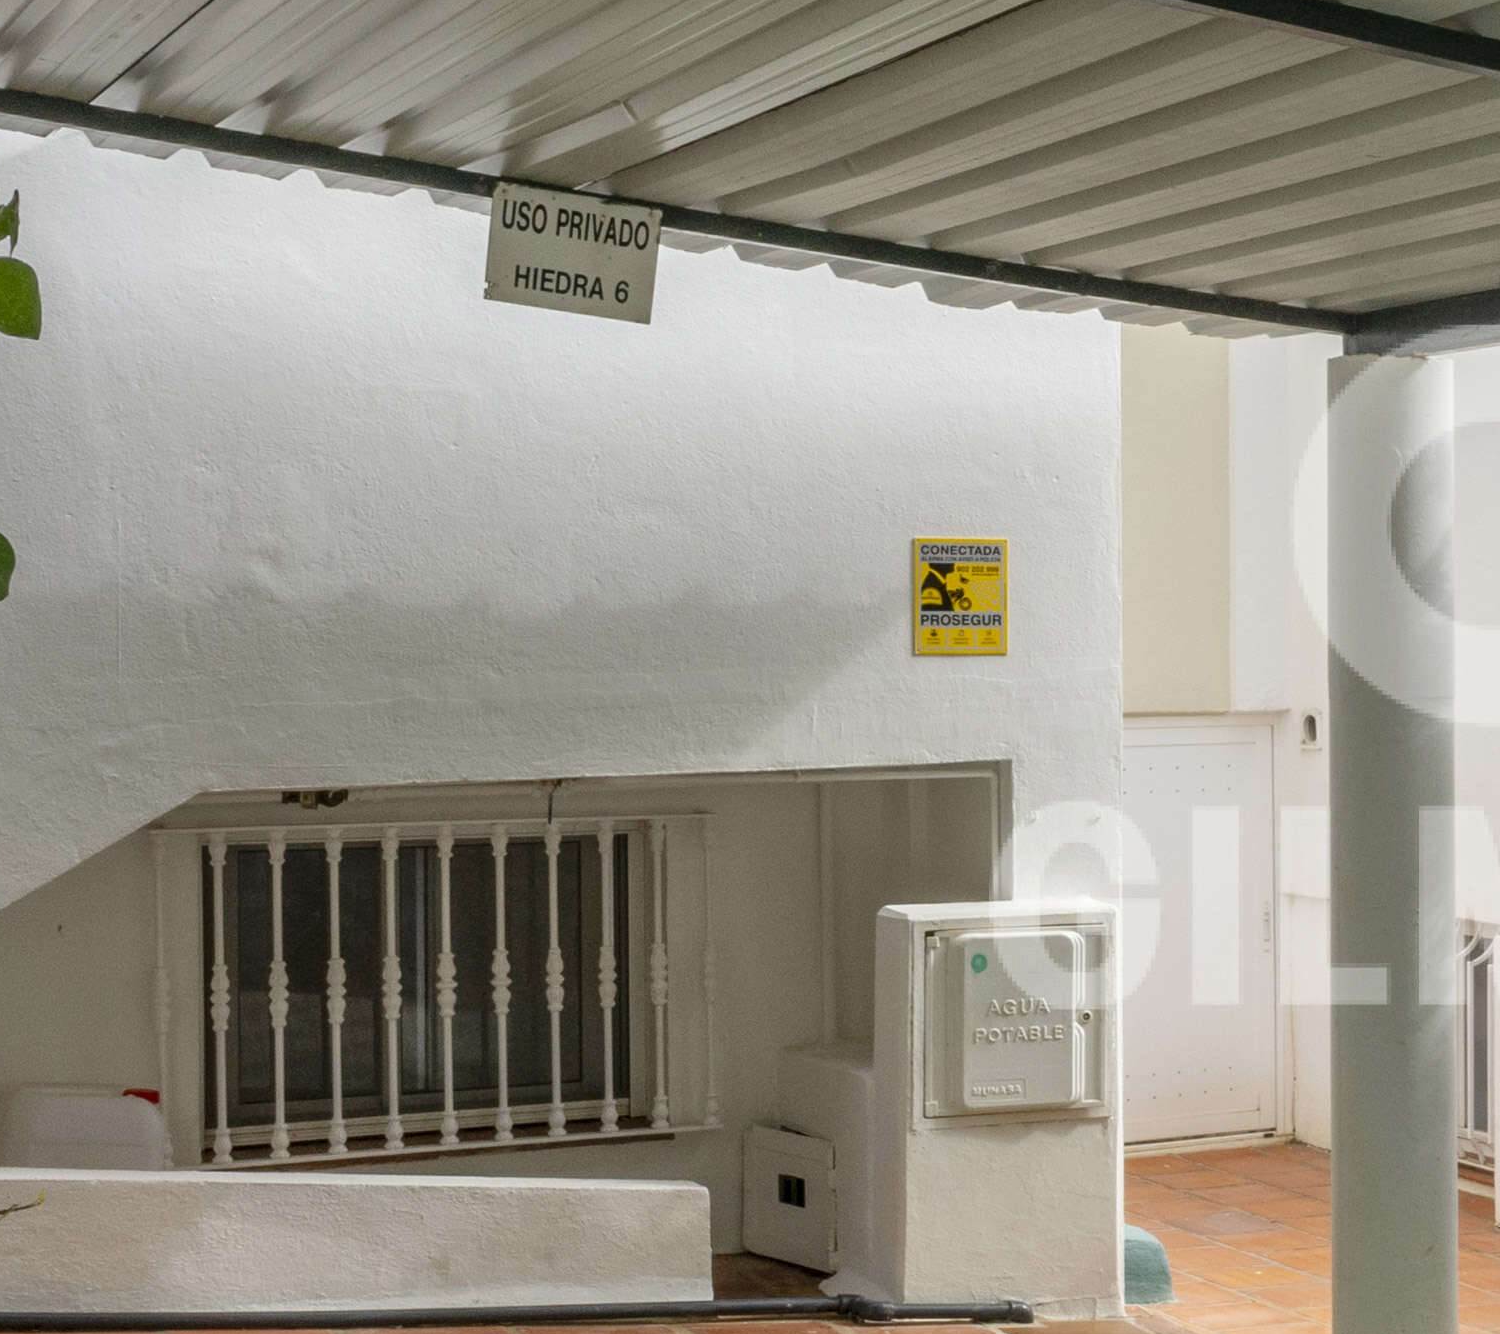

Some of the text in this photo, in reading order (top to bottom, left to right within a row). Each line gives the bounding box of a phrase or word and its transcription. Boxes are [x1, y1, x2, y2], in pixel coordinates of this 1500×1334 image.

[501, 199, 650, 251] USO PRIVADO
[513, 264, 630, 304] HIEDRA 6
[920, 544, 1001, 556] CONECTADA
[920, 614, 1002, 626] PROSEGUR
[987, 997, 1051, 1015] AGUA
[973, 1024, 1065, 1044] POTABLE
